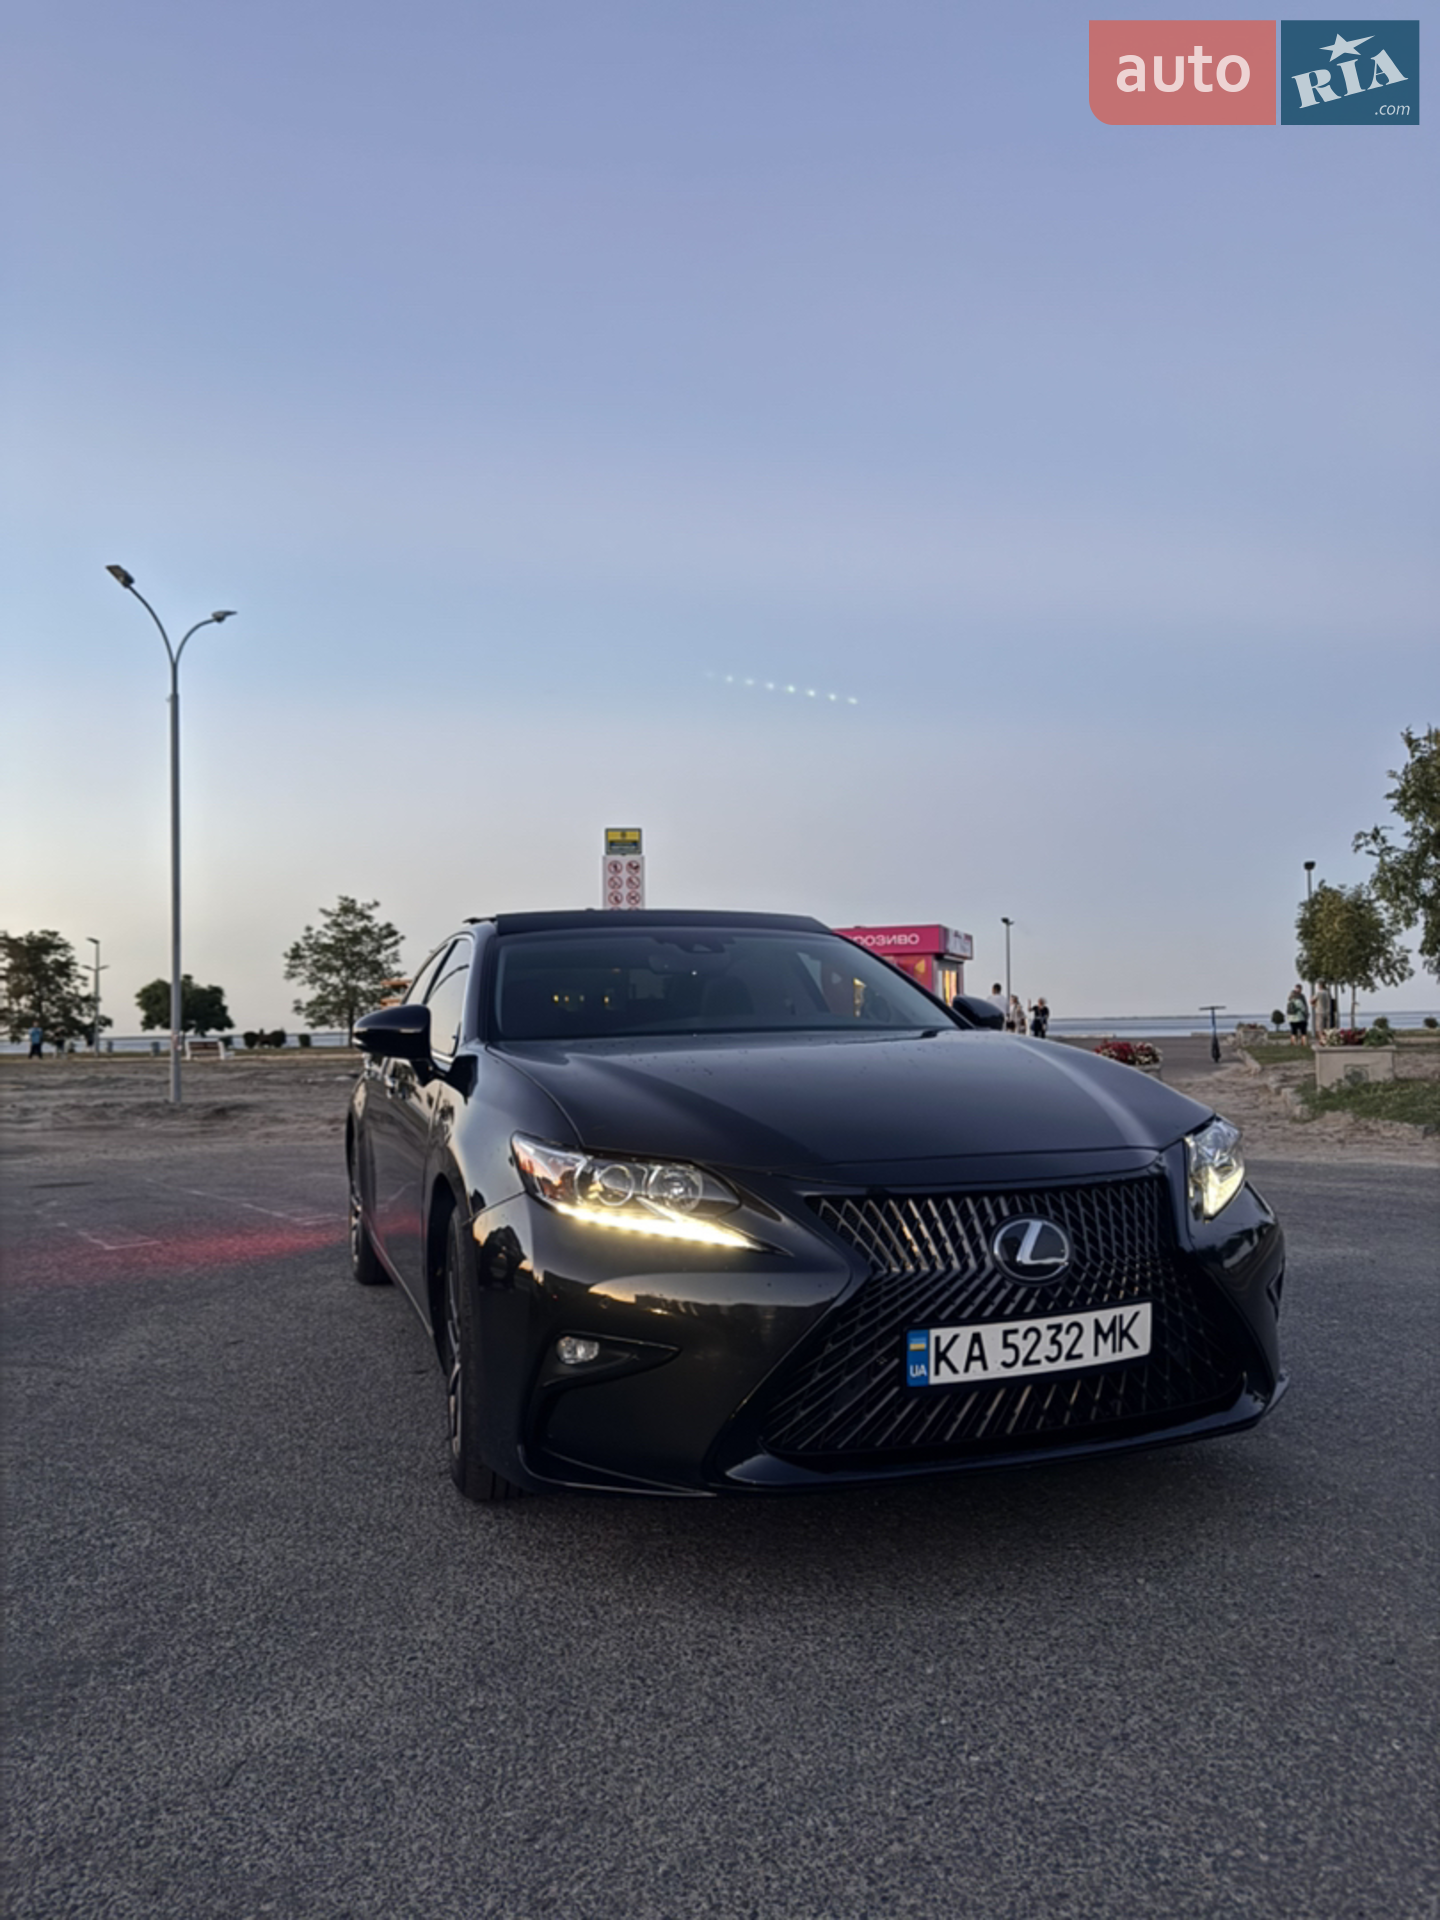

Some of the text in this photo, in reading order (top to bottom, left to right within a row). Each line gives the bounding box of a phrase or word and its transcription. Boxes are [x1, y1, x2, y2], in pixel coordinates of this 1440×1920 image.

[933, 1310, 1141, 1376] KA 5232 MK
[909, 1364, 928, 1378] UA
